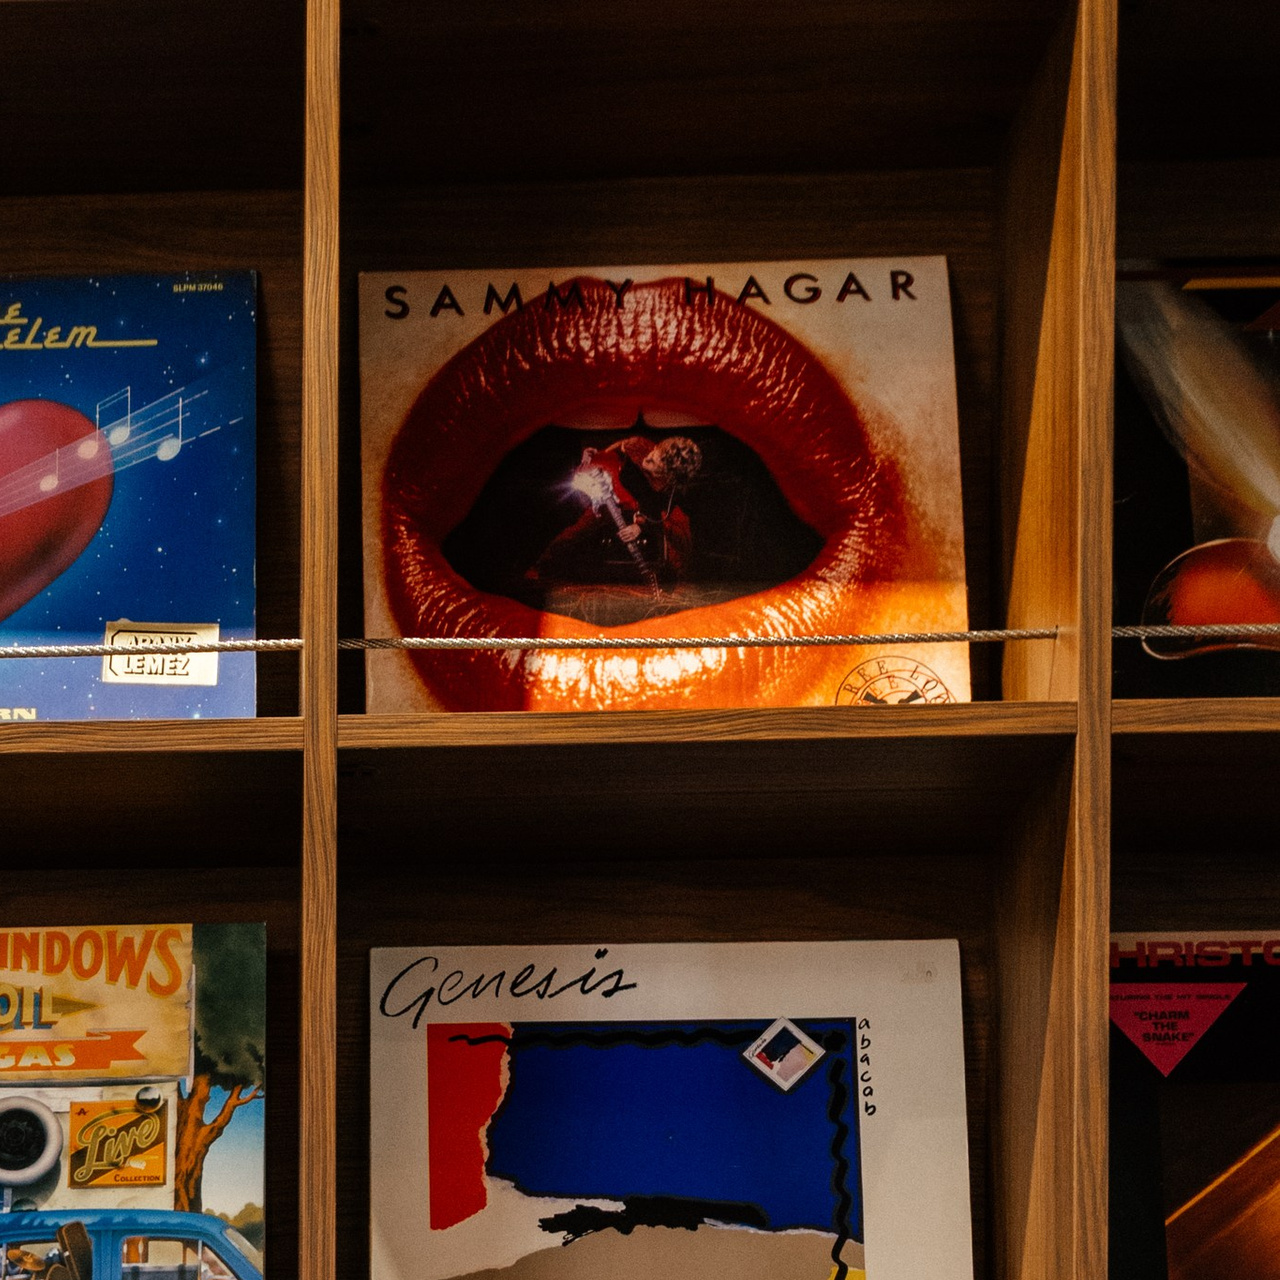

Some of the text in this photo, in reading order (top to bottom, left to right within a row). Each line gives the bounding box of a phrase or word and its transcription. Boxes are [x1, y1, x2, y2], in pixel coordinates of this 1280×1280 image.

[384, 269, 918, 320] SAMMY HAGAR
[123, 655, 190, 676] LEMEZ
[379, 948, 637, 1029] Genesis
[1152, 1022, 1178, 1031] THE
[858, 1018, 876, 1116] abacab
[73, 1107, 160, 1182] Live
